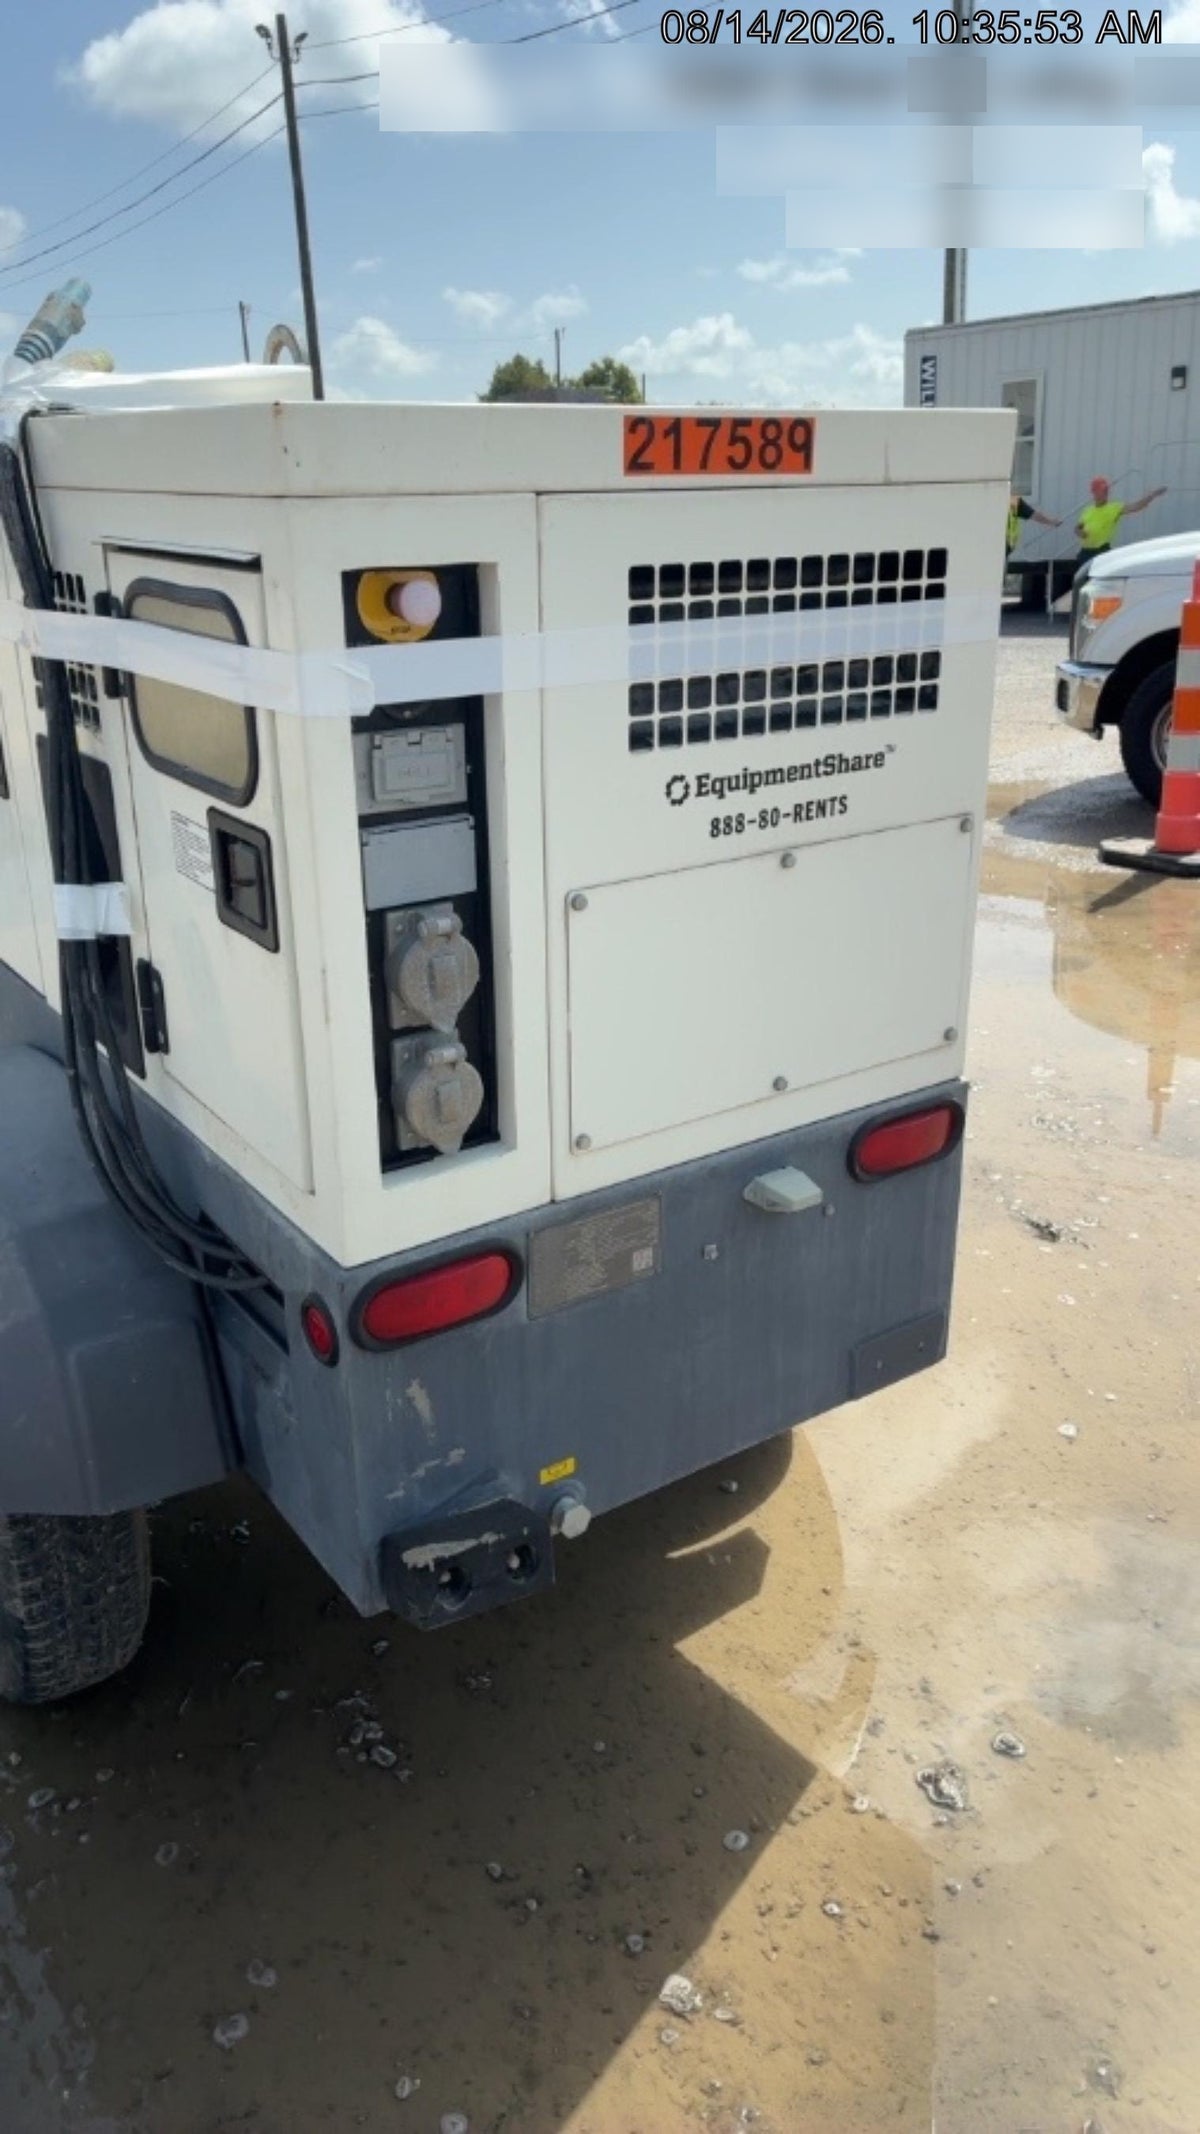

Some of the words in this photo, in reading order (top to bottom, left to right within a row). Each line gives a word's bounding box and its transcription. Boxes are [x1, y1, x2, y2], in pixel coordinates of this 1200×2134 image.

[627, 416, 813, 470] 217589
[694, 751, 886, 800] EquipmentShare
[709, 795, 849, 838] 888-80-RENTS
